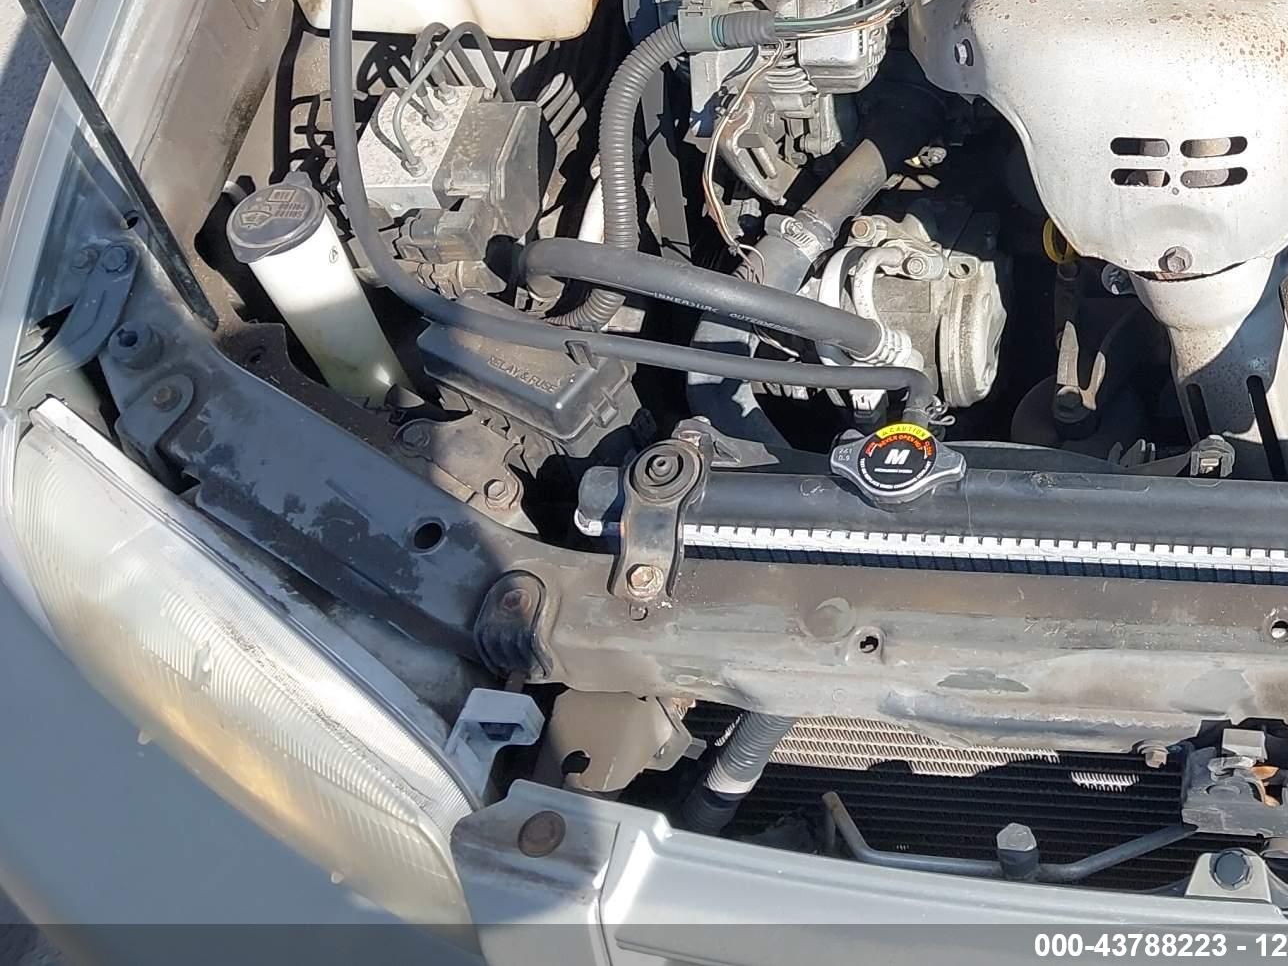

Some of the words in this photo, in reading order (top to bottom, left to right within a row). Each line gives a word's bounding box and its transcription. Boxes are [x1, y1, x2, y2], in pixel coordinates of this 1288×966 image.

[487, 355, 520, 378] RELAY
[520, 371, 529, 381] &
[529, 375, 558, 393] FUSE
[889, 425, 926, 437] CAUTION
